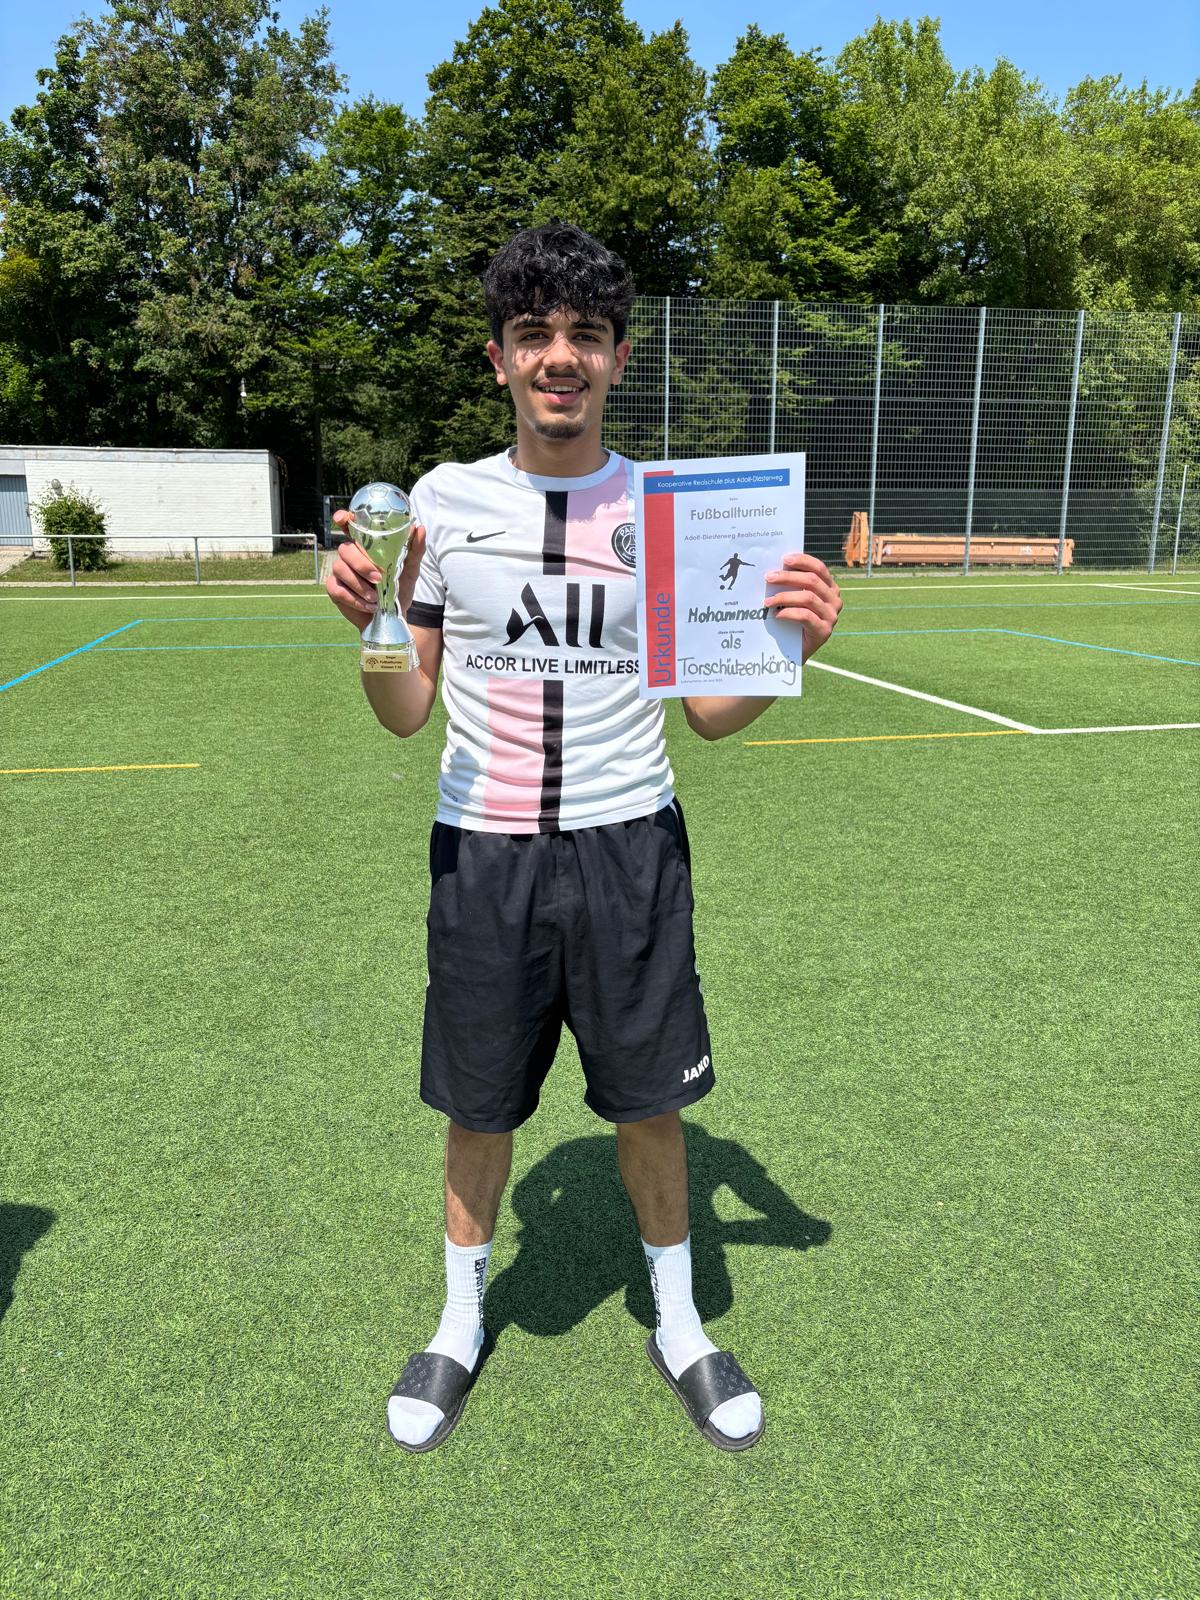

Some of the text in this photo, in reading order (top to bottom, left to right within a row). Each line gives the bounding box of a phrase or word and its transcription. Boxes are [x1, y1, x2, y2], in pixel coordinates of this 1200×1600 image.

[657, 474, 784, 488] Kooperative Realschule plus Adolf-Diesterweg
[690, 505, 778, 521] Fußballturnier
[684, 529, 784, 543] Adolf-Diesterweg Realschule plus
[652, 592, 671, 683] Urkunde
[721, 634, 742, 649] als
[466, 654, 517, 672] ACCOR
[521, 657, 559, 673] LIVE
[682, 1054, 710, 1084] JAKO
